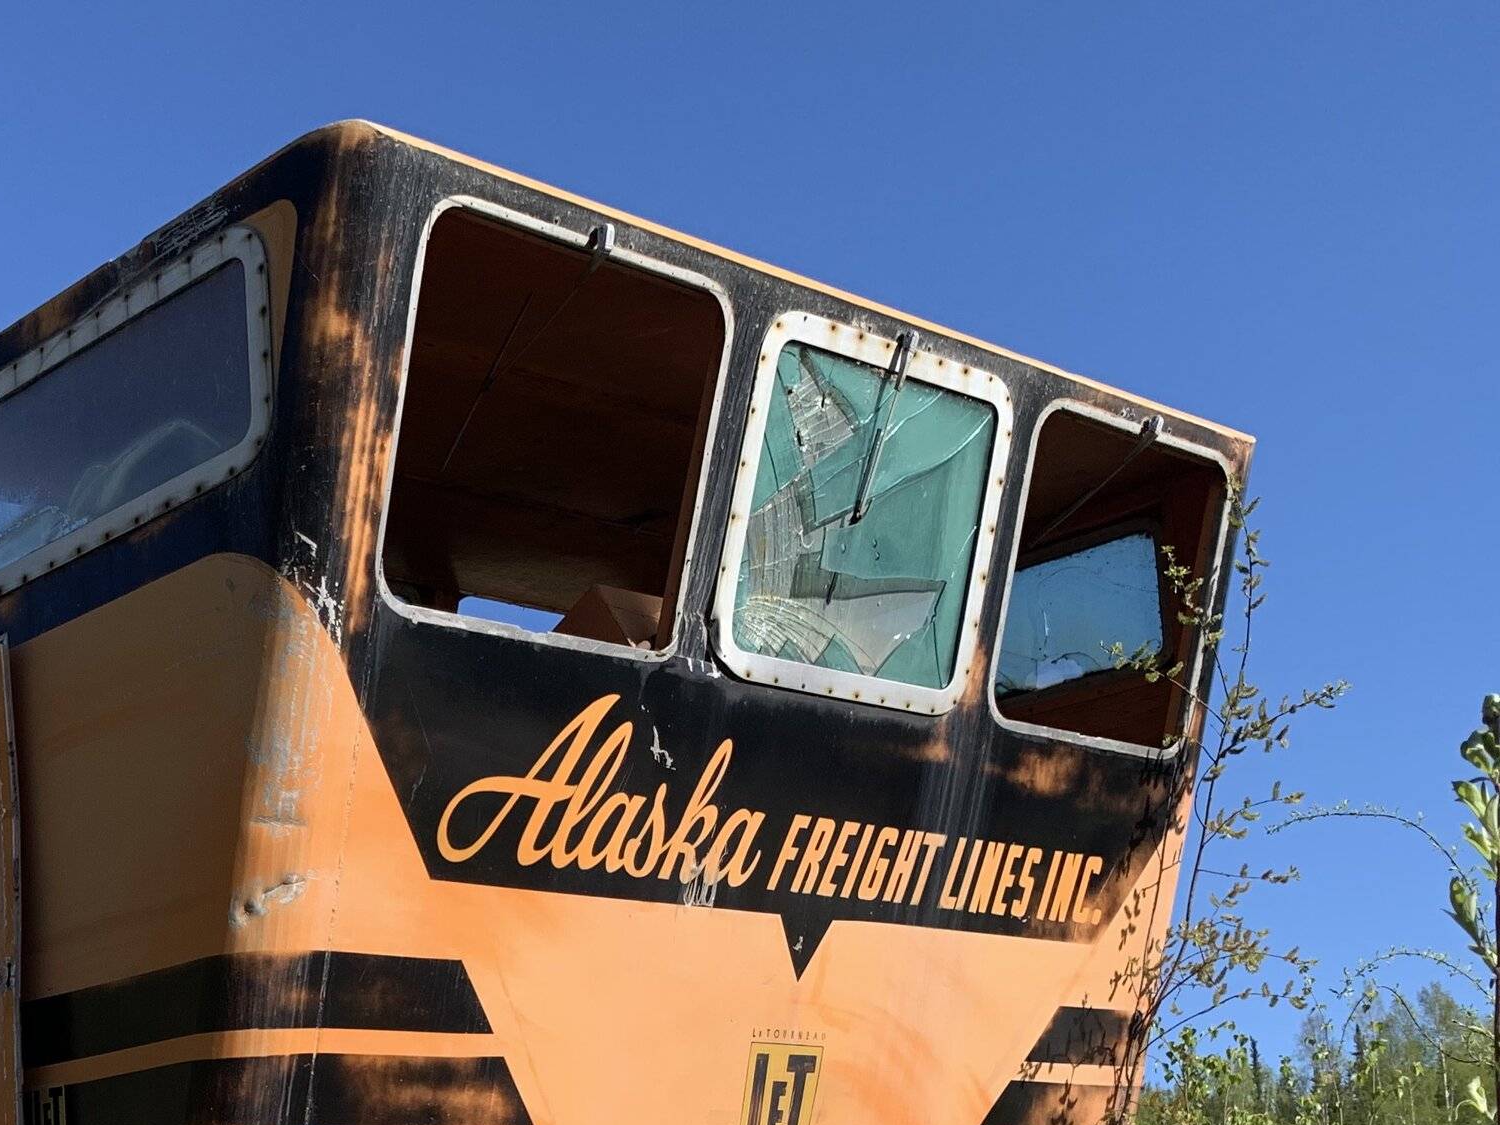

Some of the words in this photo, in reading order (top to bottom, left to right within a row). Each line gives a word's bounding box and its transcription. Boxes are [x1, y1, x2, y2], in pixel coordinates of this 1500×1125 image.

[436, 693, 766, 888] Alaska
[766, 813, 948, 906] FREIGHT
[937, 836, 1044, 918] LINES
[1036, 849, 1104, 925] INC.
